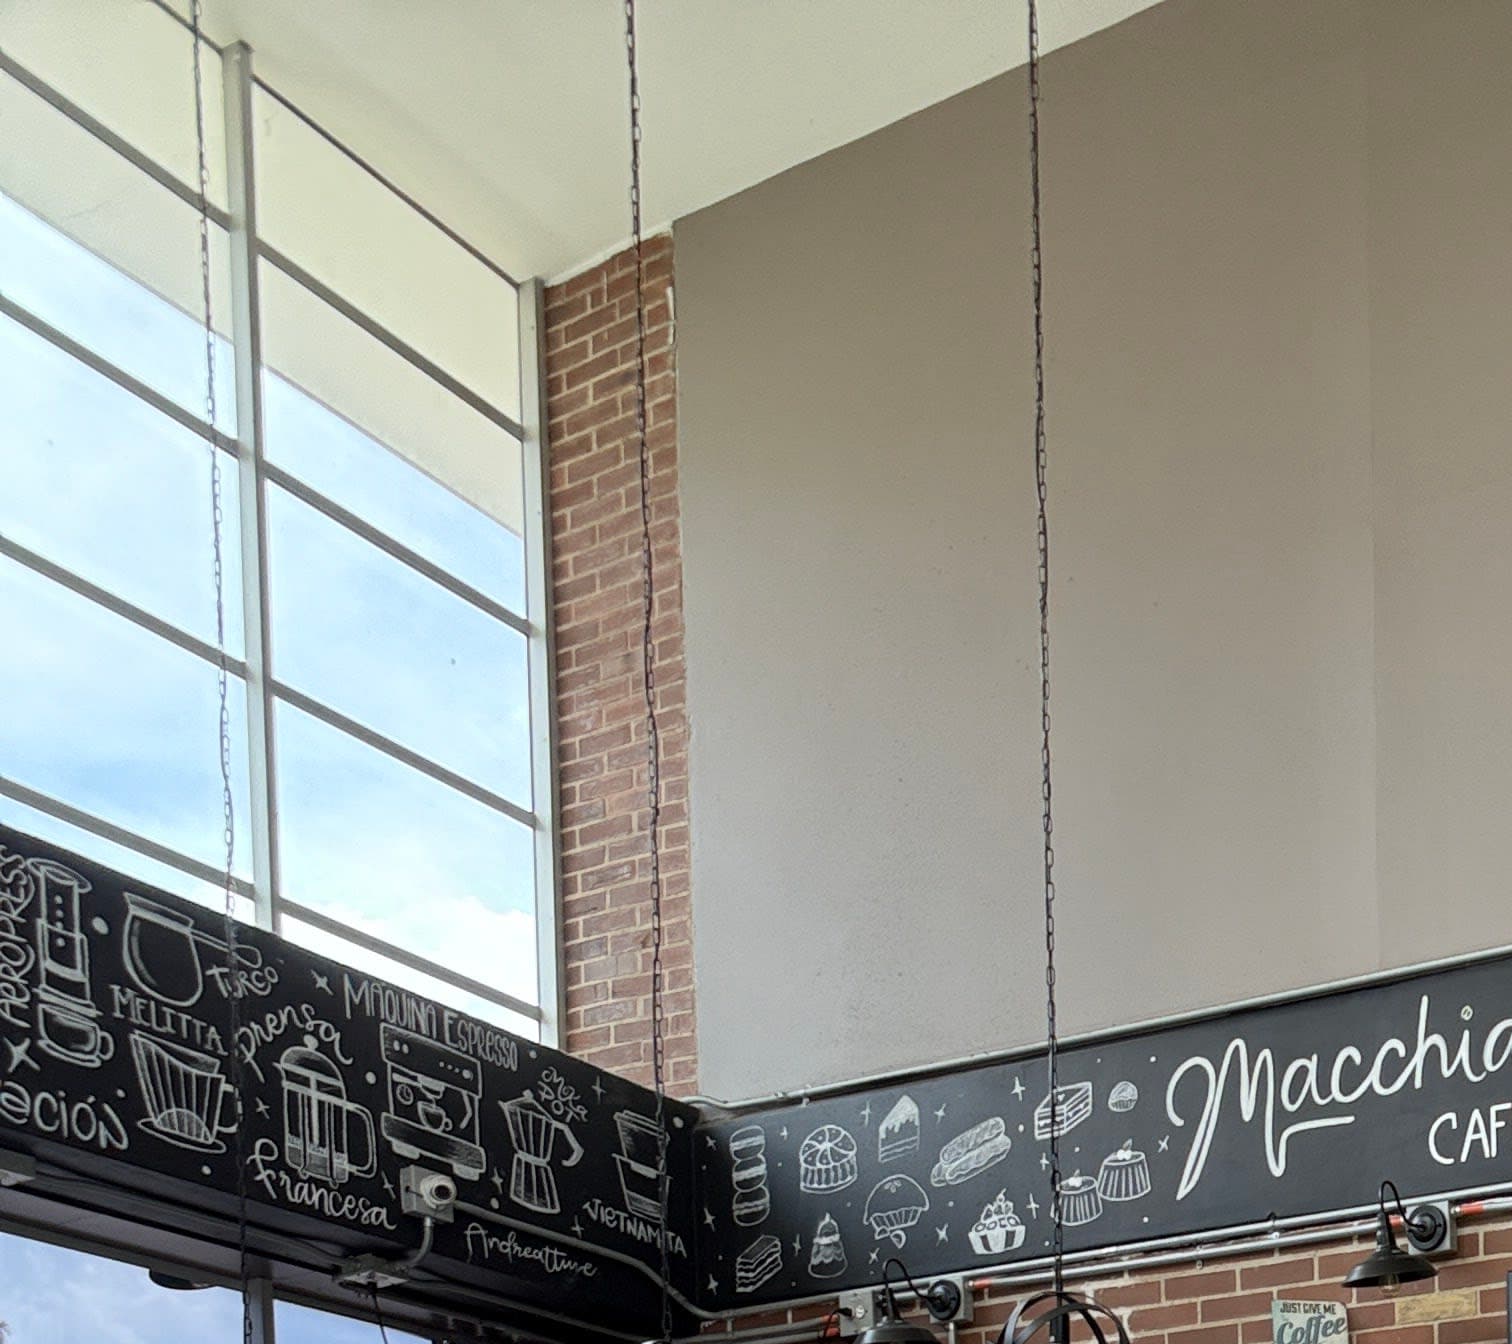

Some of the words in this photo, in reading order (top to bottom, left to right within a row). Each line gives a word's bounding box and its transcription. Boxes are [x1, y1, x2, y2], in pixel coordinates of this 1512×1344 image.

[109, 984, 228, 1056] MELITTA
[1280, 1302, 1301, 1314] JUST
[1303, 1303, 1322, 1314] GIVE
[1323, 1304, 1337, 1315] ME
